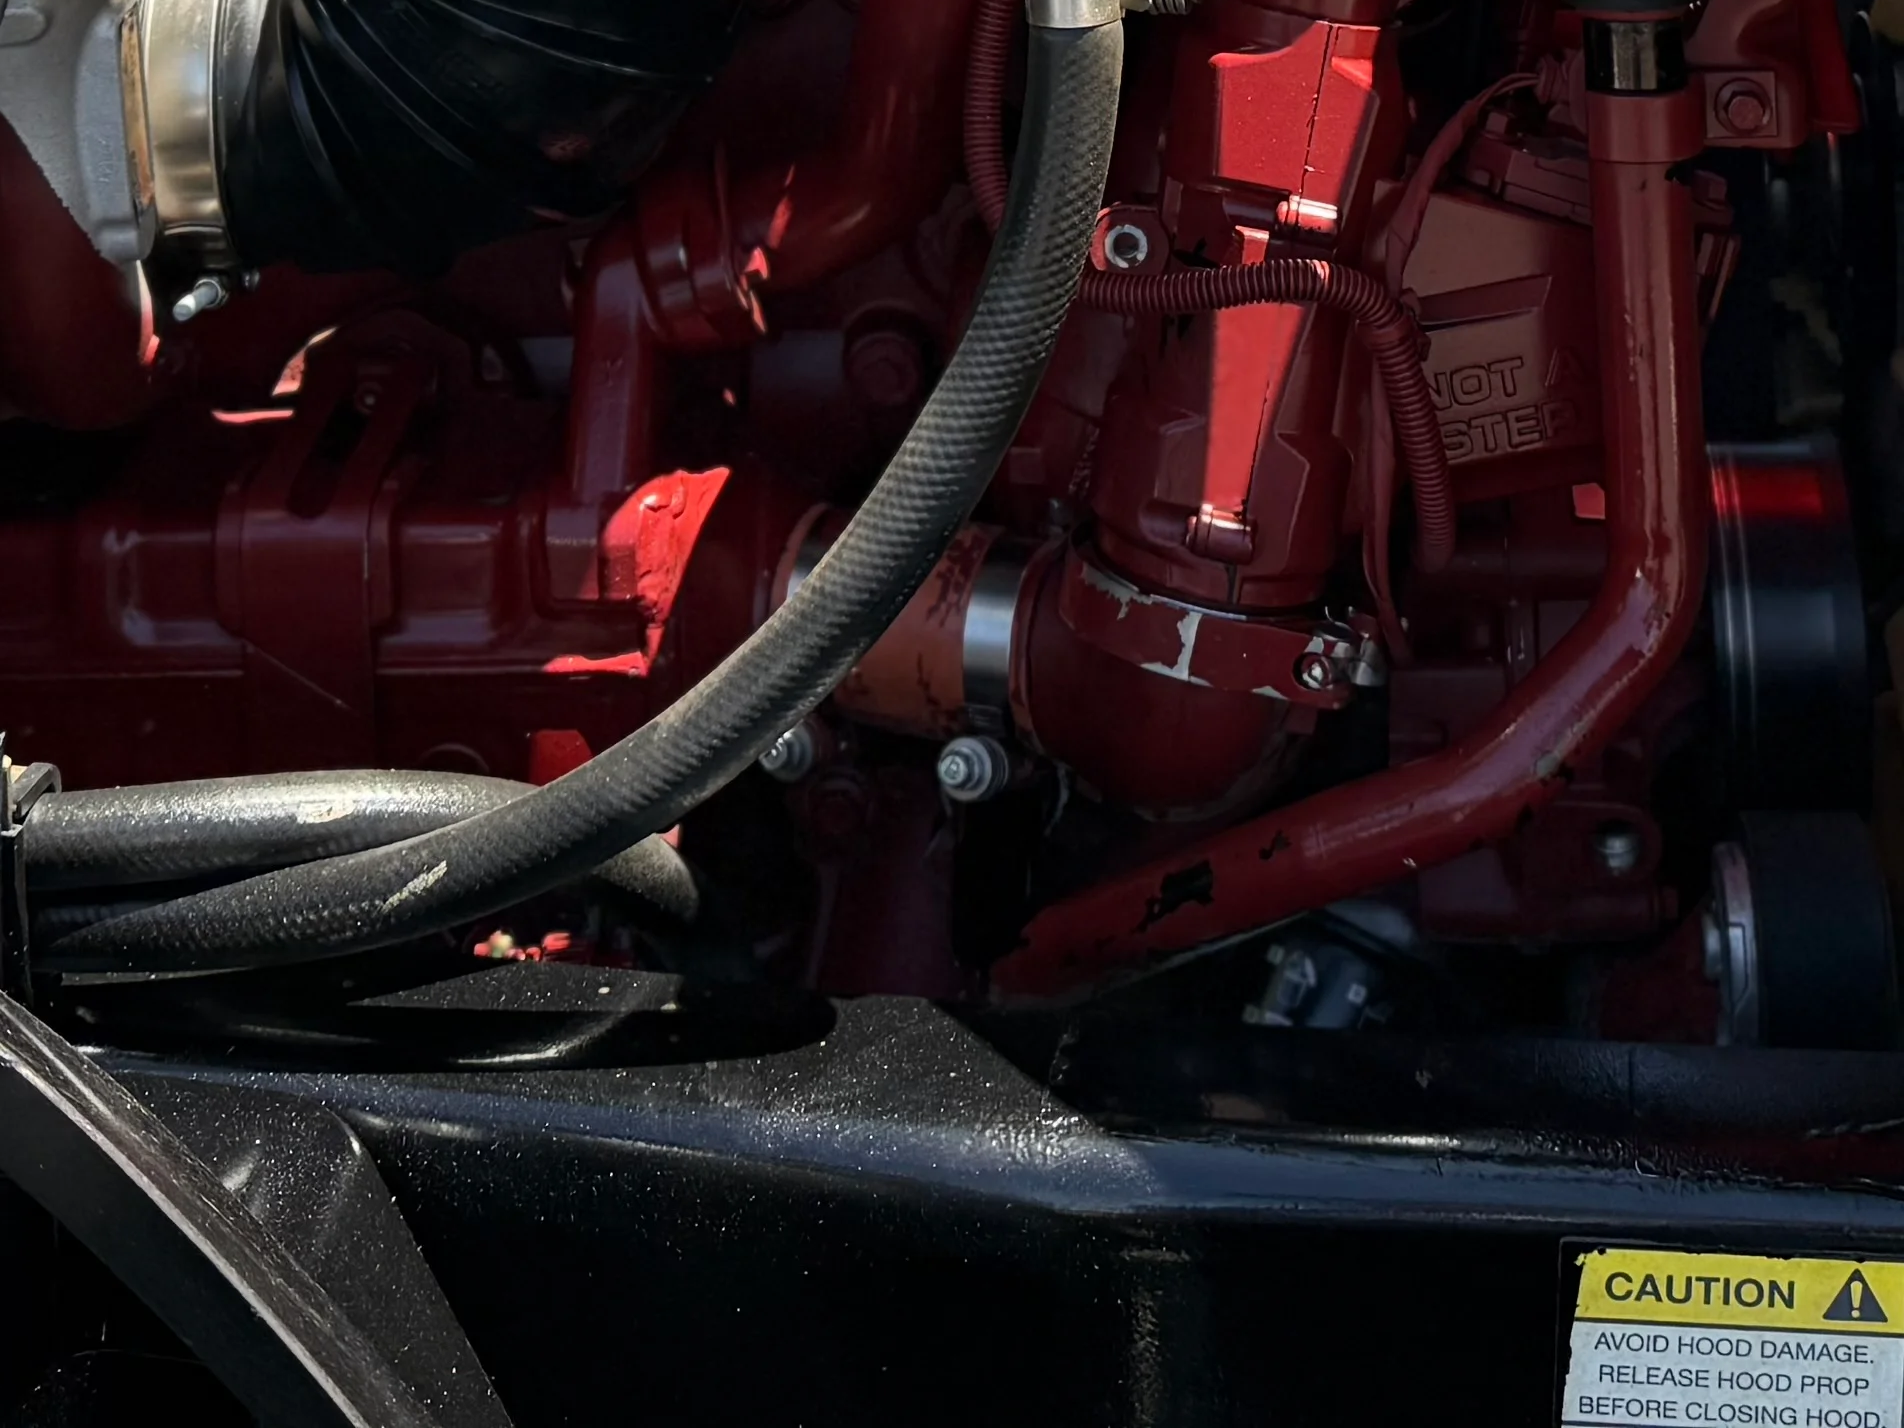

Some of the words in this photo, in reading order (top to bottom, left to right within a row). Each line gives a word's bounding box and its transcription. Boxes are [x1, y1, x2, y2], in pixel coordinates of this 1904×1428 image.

[1604, 1271, 1796, 1310] CAUTION
[1594, 1332, 1669, 1354] AVOID
[1677, 1335, 1752, 1357] HOOD
[1760, 1340, 1874, 1364] DAMAGE.
[1599, 1364, 1709, 1388] RELEASE
[1717, 1370, 1792, 1392] HOOD
[1800, 1375, 1869, 1397] PROP
[1578, 1396, 1678, 1420] BEFORE
[1685, 1401, 1797, 1425] CLOSING
[1806, 1408, 1886, 1428] HOOD.
